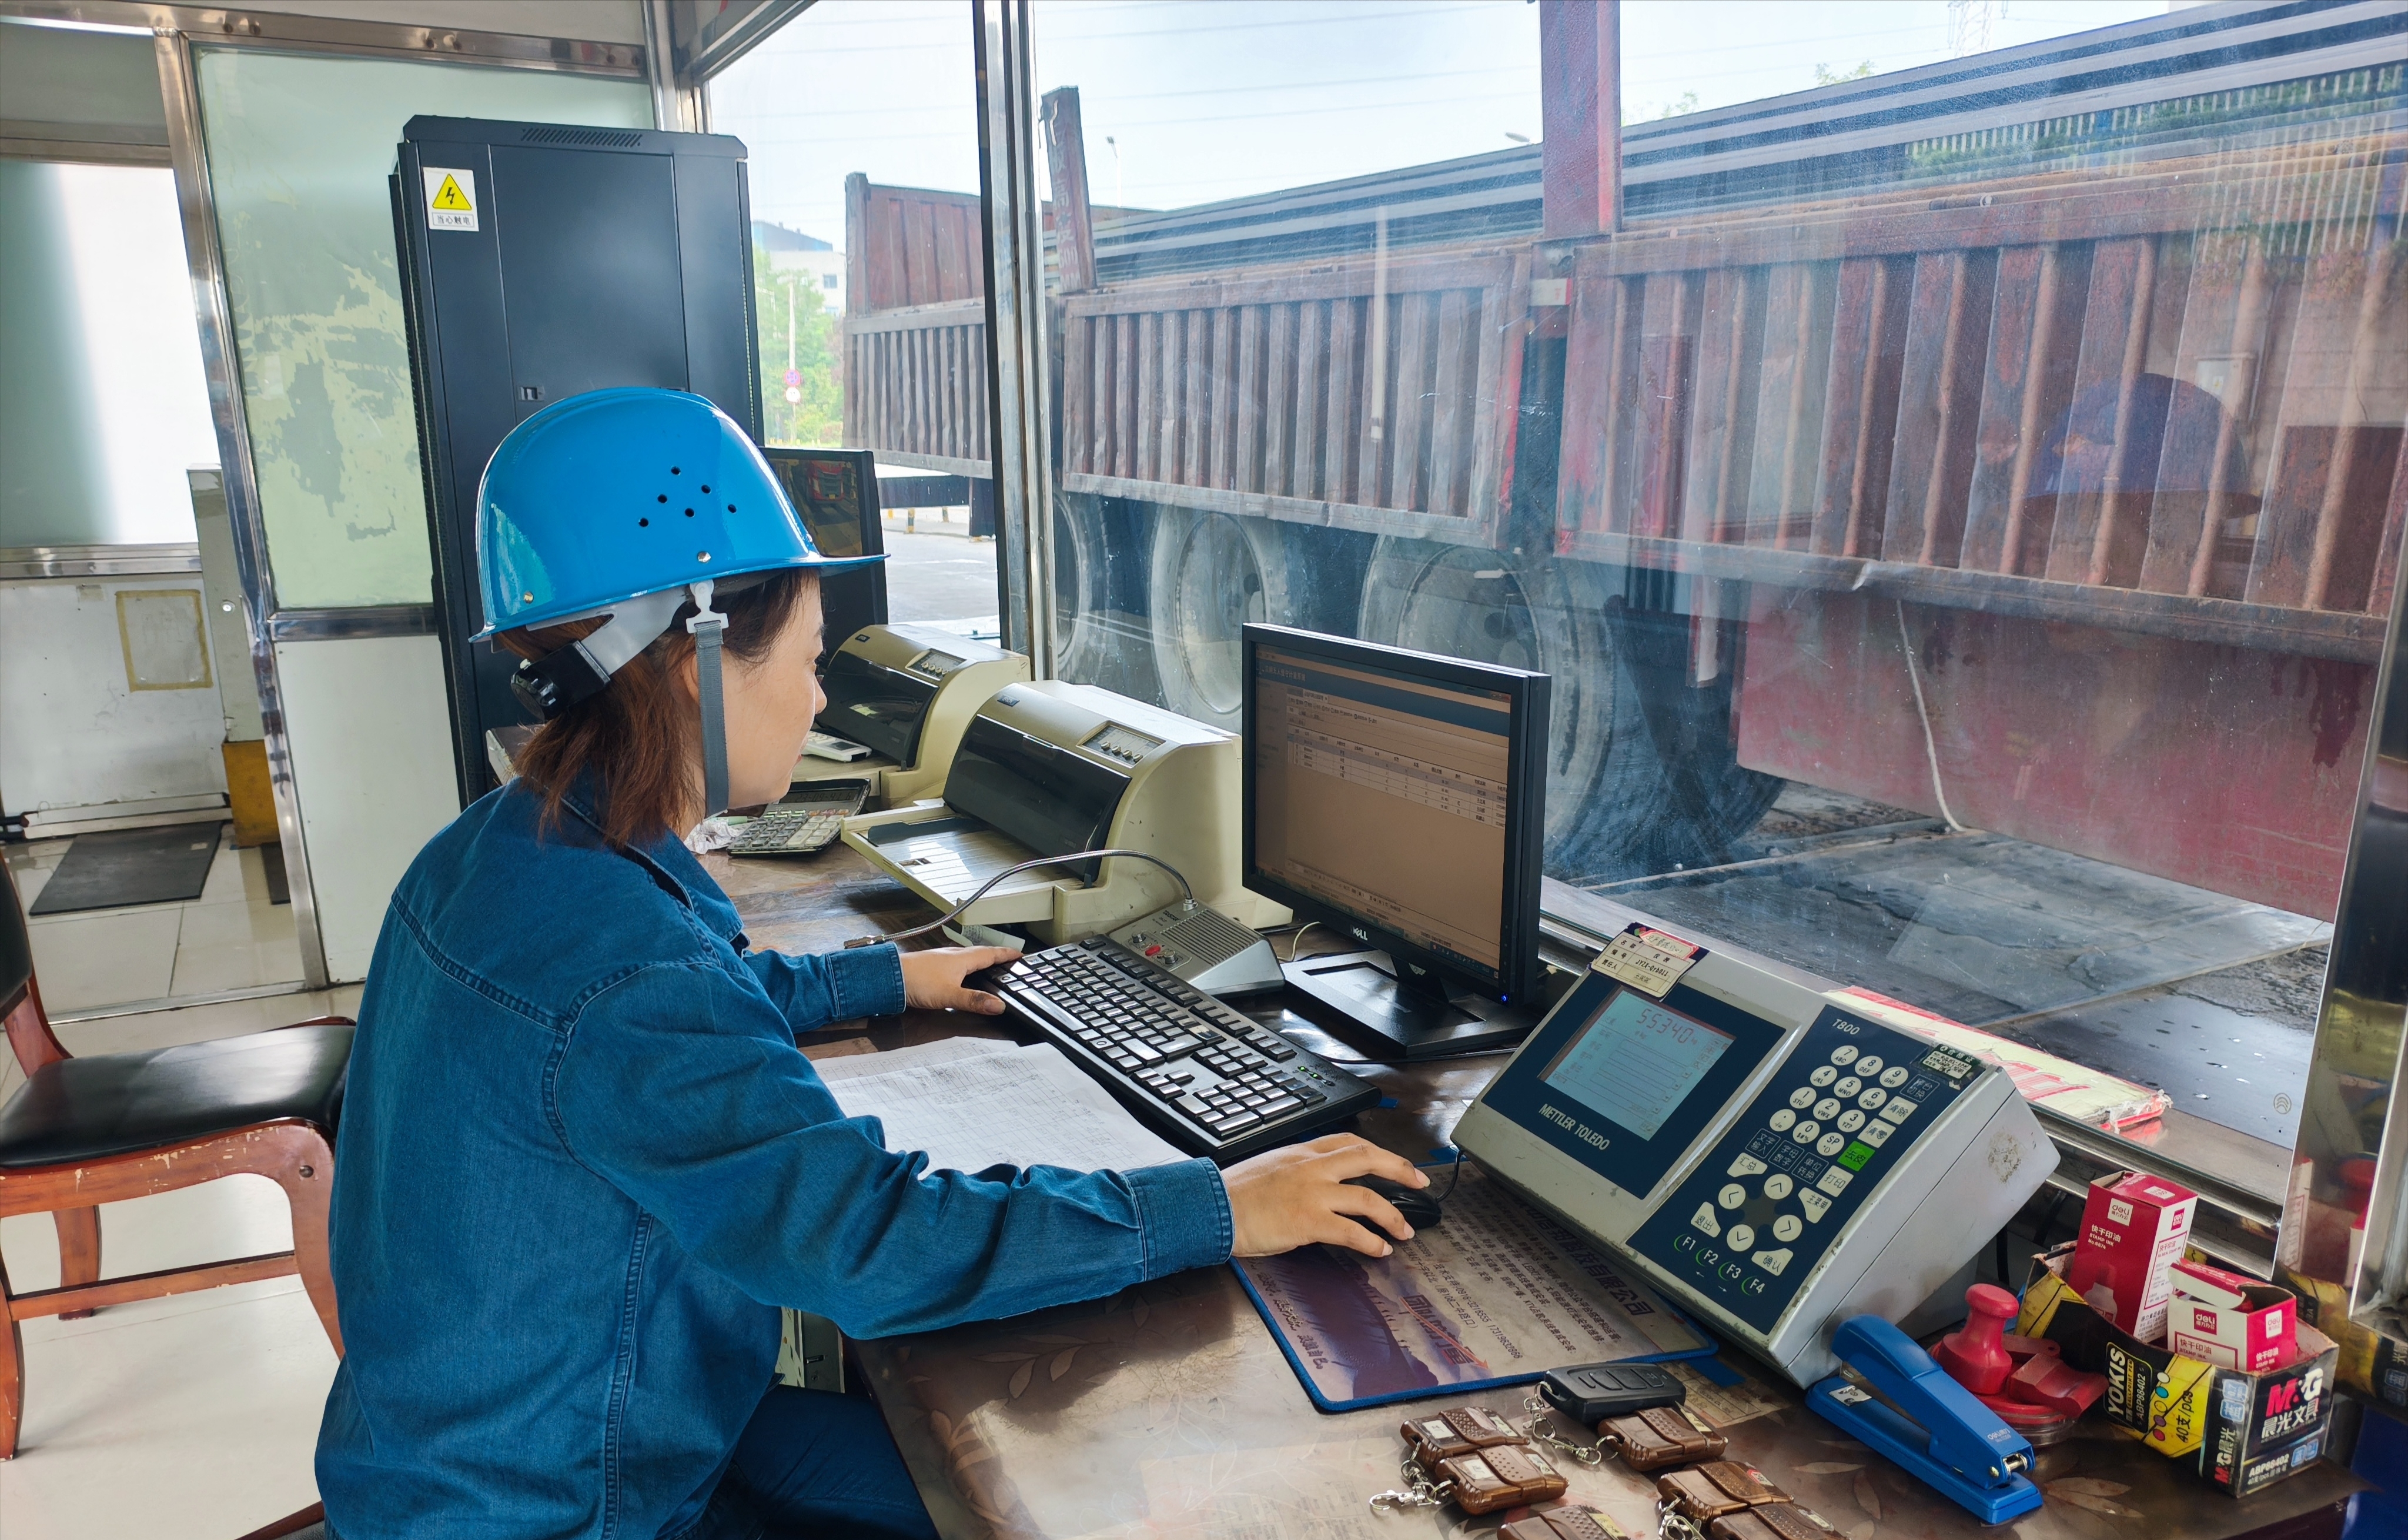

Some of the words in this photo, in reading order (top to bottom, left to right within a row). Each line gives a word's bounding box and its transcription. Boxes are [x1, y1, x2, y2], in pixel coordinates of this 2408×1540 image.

[437, 215, 470, 225] 当心触电
[1350, 924, 1368, 941] DELL
[1602, 959, 1618, 970] 责任人
[1636, 1008, 1694, 1044] 55340
[1832, 1018, 1860, 1035] T800
[1867, 1059, 1877, 1067] 8
[1947, 1048, 1974, 1063] 合格证
[1813, 1076, 1823, 1084] JKL
[1846, 1080, 1855, 1088] 5
[1838, 1087, 1851, 1096] MNO
[1828, 1101, 1835, 1110] 2
[1862, 1098, 1875, 1108] PQR
[1888, 1103, 1908, 1118] 清除
[1817, 1108, 1831, 1118] VWX
[1849, 1113, 1859, 1121] 3
[1539, 1103, 1576, 1131] METTLER
[1574, 1124, 1610, 1150] TOLEDO
[1804, 1124, 1814, 1133] 0
[1865, 1125, 1888, 1140] 清零
[1757, 1133, 1776, 1145] 文字
[1827, 1135, 1840, 1145] SP
[1751, 1143, 1767, 1154] 输入
[1781, 1145, 1800, 1158] 字母
[1737, 1155, 1757, 1171] 汇总
[1773, 1153, 1792, 1166] 数字
[1804, 1157, 1823, 1171] 单位
[1845, 1150, 1866, 1165] 去皮
[1797, 1165, 1815, 1181] 转换
[1824, 1174, 1847, 1188] 打印
[1806, 1194, 1829, 1210] 主菜单
[2112, 1204, 2130, 1215] deli
[1694, 1214, 1714, 1231] 退出
[2089, 1233, 2105, 1242] STAMP
[2091, 1224, 2121, 1242] 快干印油
[1682, 1236, 1697, 1251] F1
[1703, 1250, 1718, 1265] F2
[1762, 1254, 1781, 1272] 确认
[1726, 1264, 1741, 1278] F3
[1750, 1278, 1765, 1294] F4
[2196, 1314, 2215, 1324] deli
[2196, 1321, 2215, 1330] 得力办公
[2267, 1316, 2280, 1326] deli
[2179, 1338, 2212, 1355] 快干印油
[2256, 1347, 2279, 1362] 快干印油
[2108, 1347, 2126, 1416] YOKIS
[2136, 1373, 2146, 1421] ABP88402
[2176, 1390, 2194, 1443] 40支/pcs
[2223, 1401, 2242, 1418] 蓝
[2262, 1398, 2319, 1439] 晨光文具
[2219, 1427, 2236, 1454] 晨光
[2249, 1453, 2289, 1478] ABP88402
